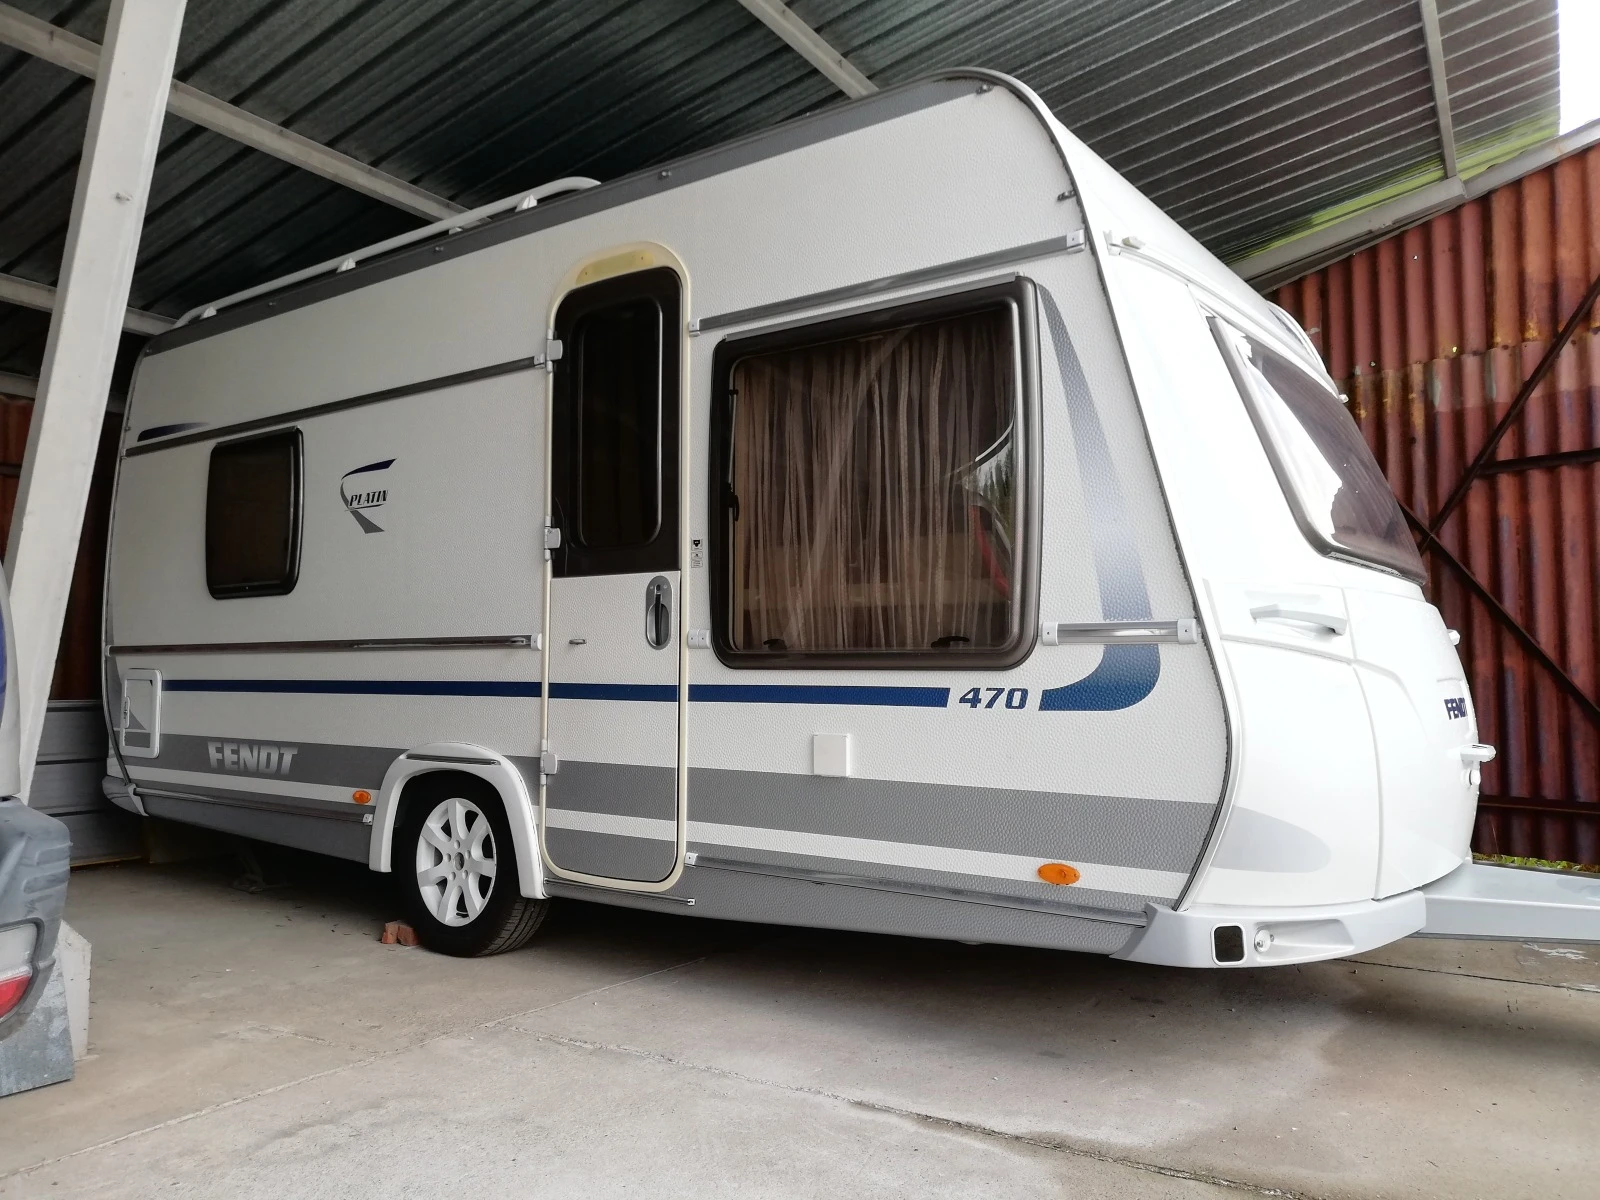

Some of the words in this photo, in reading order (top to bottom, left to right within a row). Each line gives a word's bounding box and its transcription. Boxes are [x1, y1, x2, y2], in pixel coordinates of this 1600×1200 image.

[349, 489, 389, 507] PLATIN
[958, 687, 1029, 710] 470
[207, 741, 299, 775] FENDT
